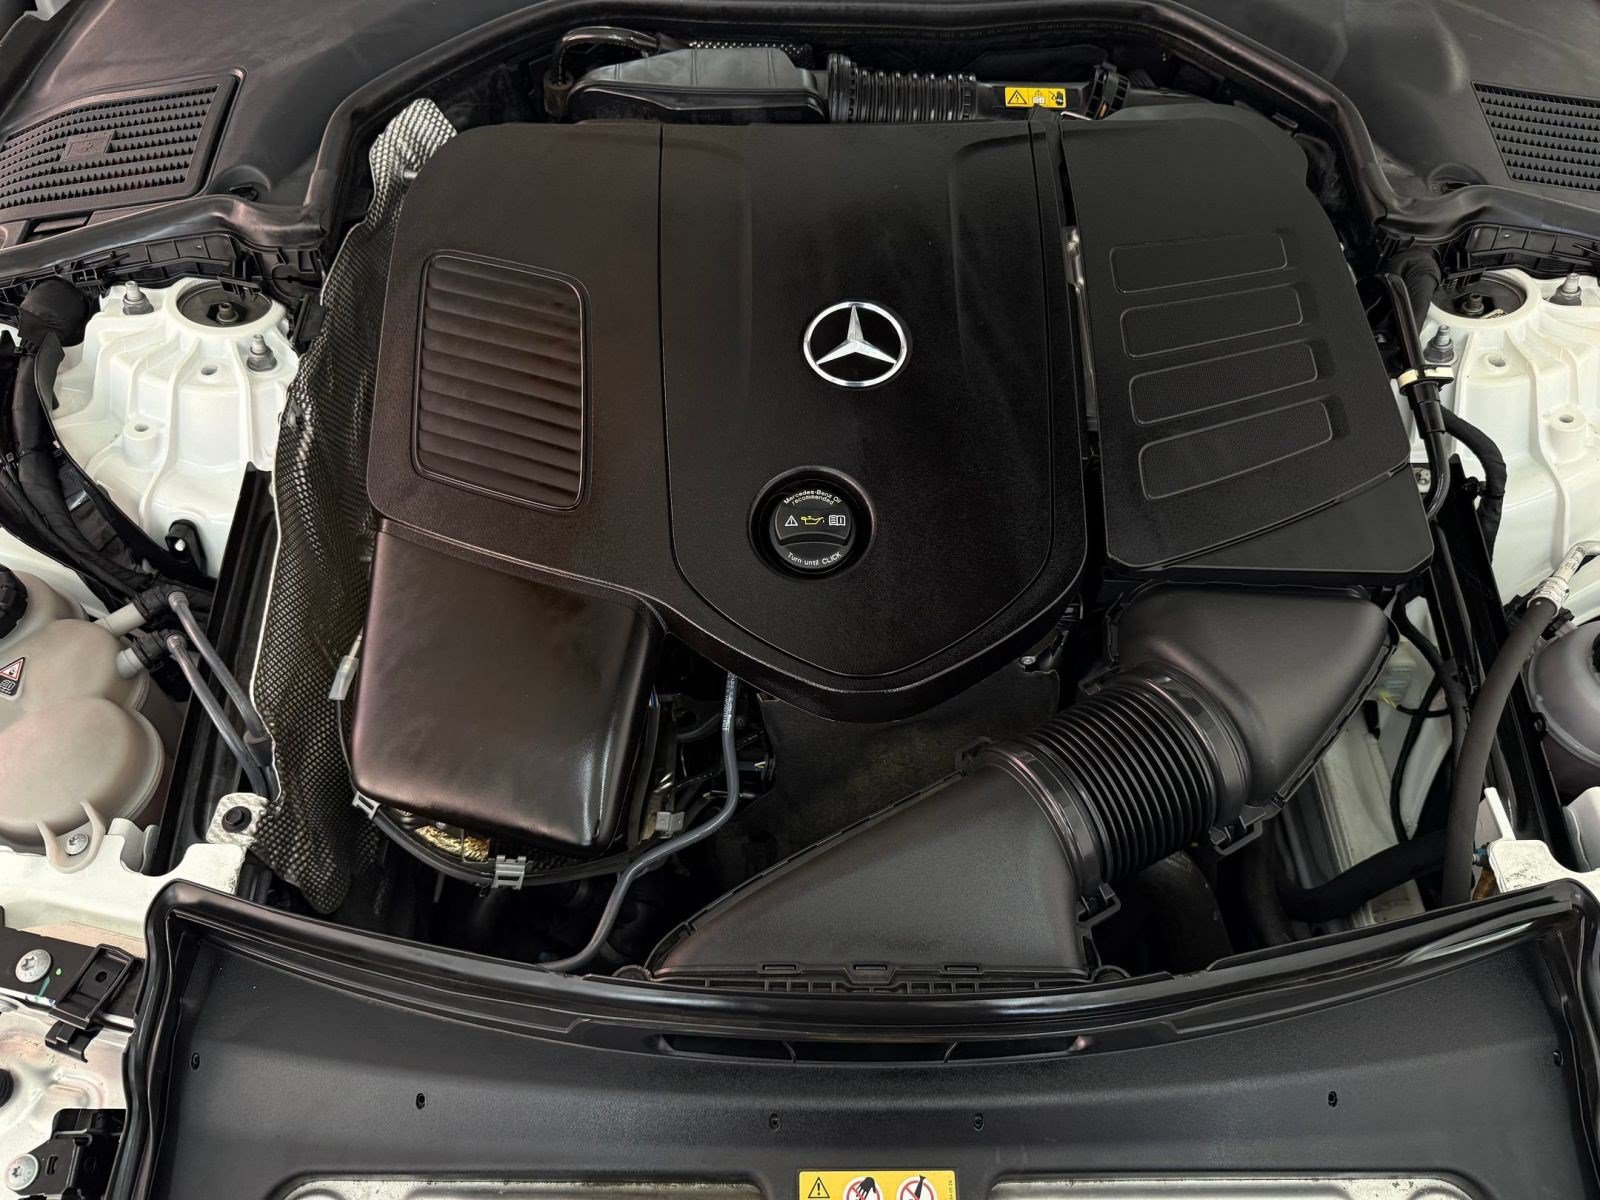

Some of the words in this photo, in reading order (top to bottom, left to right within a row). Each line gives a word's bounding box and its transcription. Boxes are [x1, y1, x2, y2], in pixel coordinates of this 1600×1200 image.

[783, 489, 832, 504] Mercedes-Benz
[834, 496, 842, 504] Oil
[791, 495, 834, 505] recommended
[787, 552, 802, 564] Turn
[822, 552, 842, 564] CLICK
